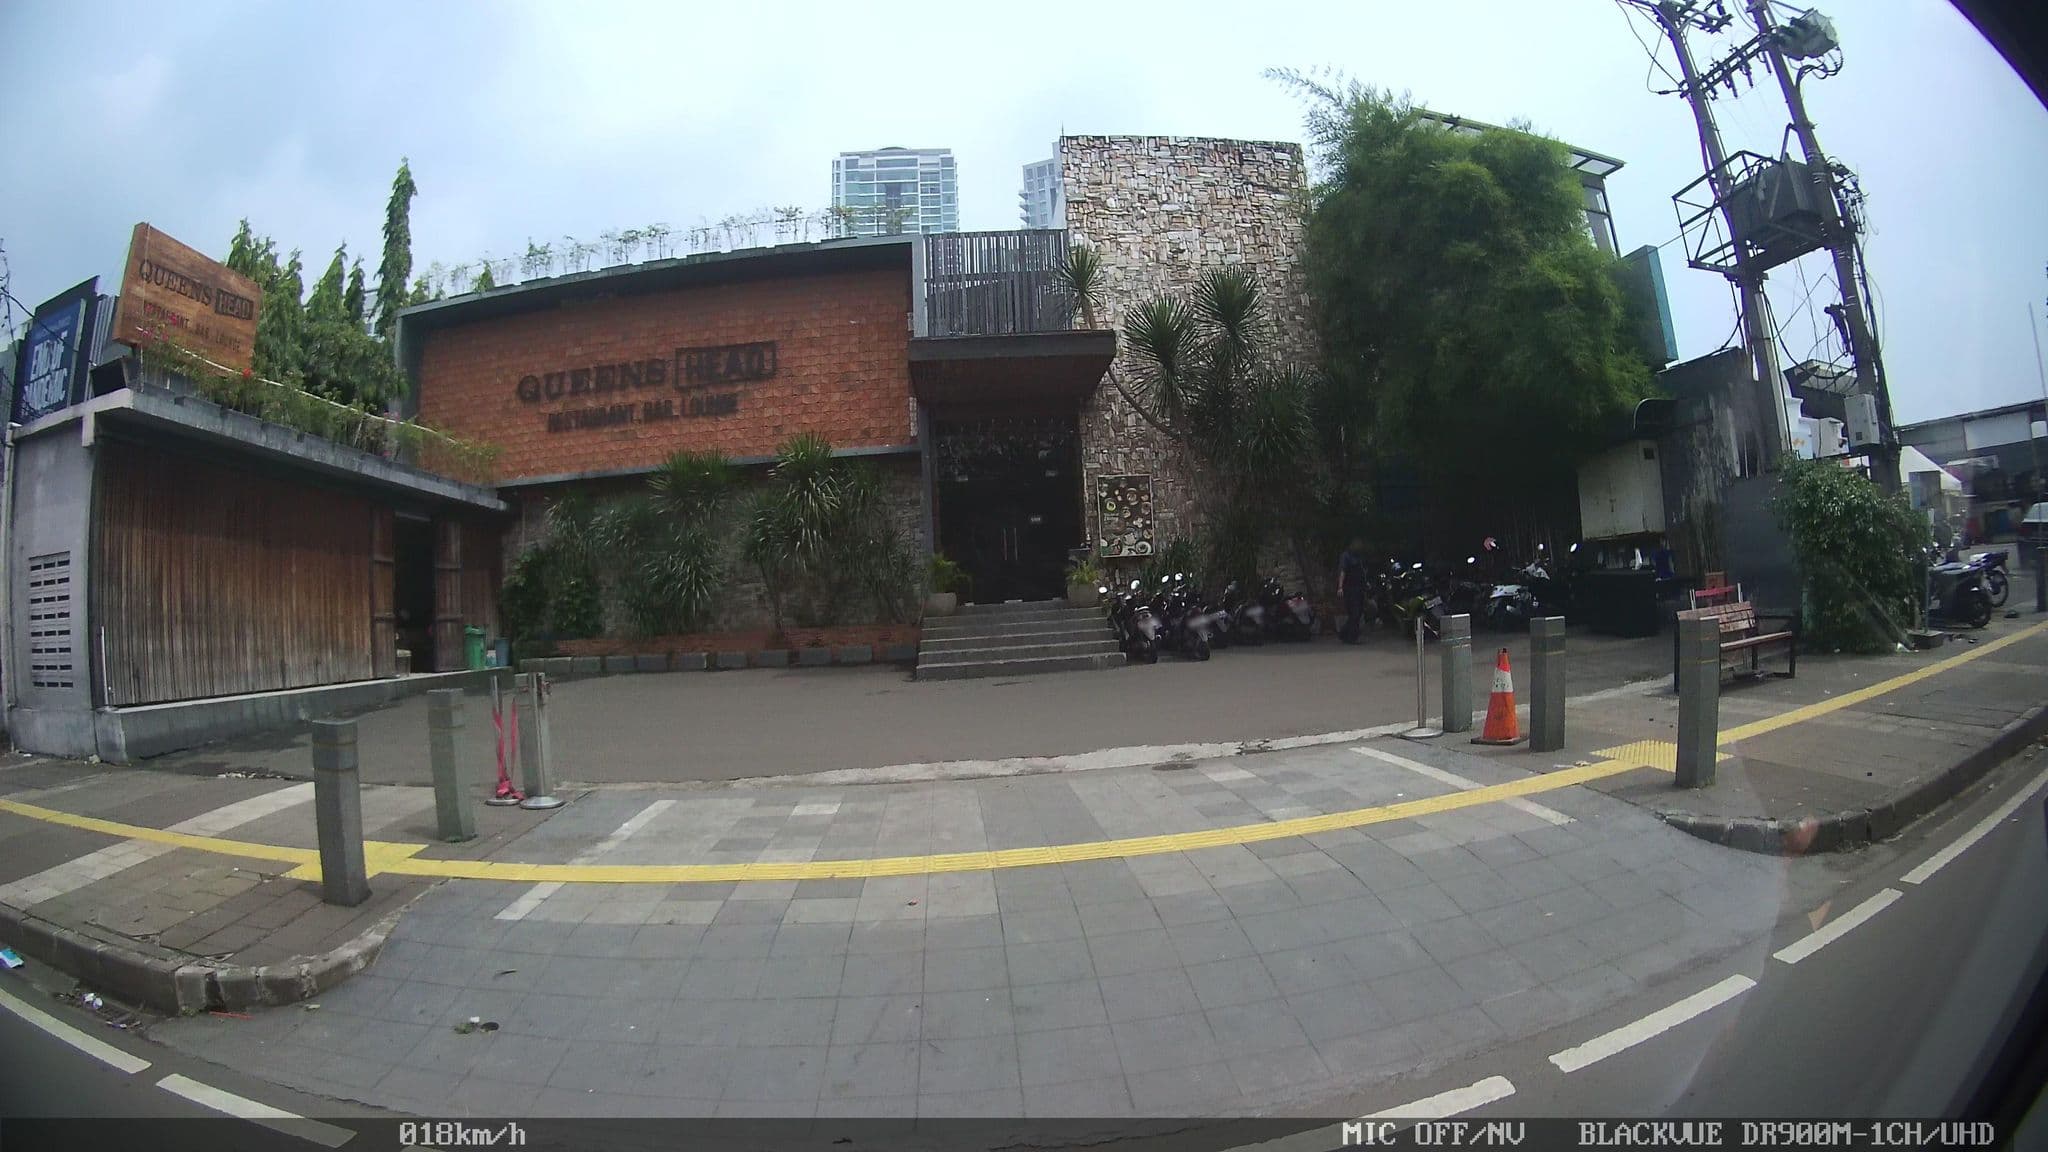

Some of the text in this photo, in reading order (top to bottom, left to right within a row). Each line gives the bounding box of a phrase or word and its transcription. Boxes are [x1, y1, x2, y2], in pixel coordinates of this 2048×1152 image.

[140, 259, 253, 319] QUEENS HEAD
[518, 345, 773, 402] QUEENS HEAD
